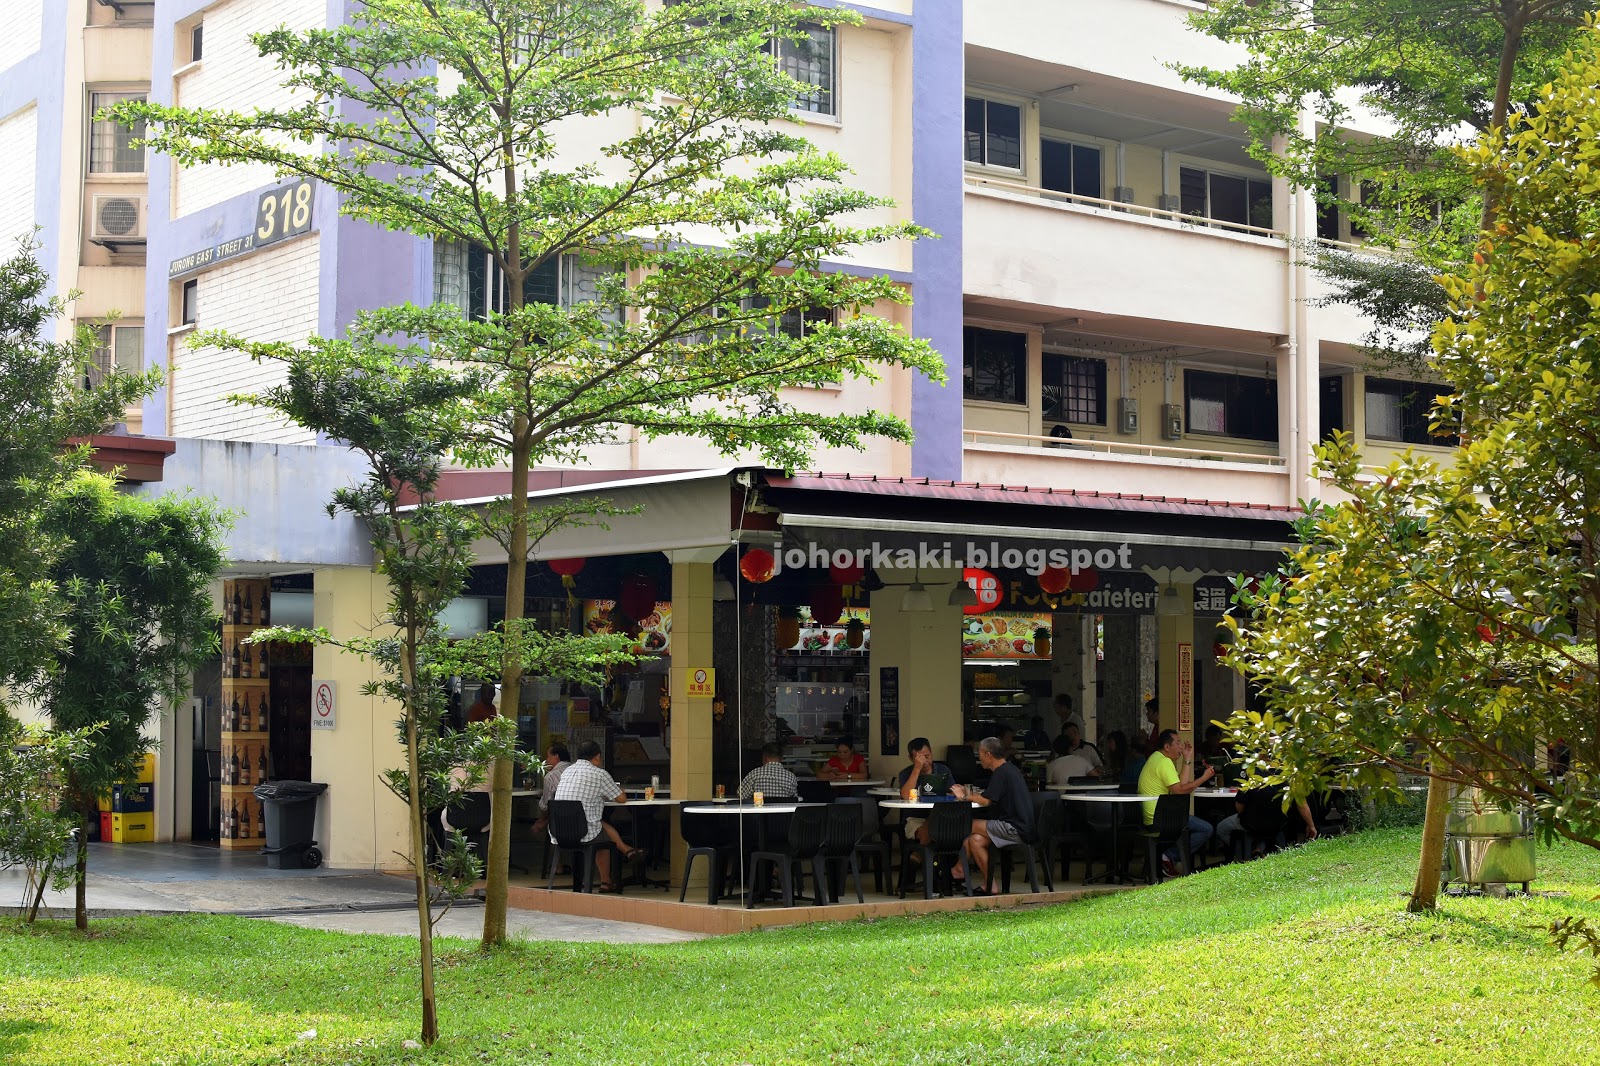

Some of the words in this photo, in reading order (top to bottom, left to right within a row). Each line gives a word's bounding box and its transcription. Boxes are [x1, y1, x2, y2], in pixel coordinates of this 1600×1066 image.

[258, 183, 312, 239] 318
[170, 258, 195, 273] JURONG
[196, 249, 213, 265] EAST
[216, 238, 243, 257] STREET
[244, 234, 254, 248] 31
